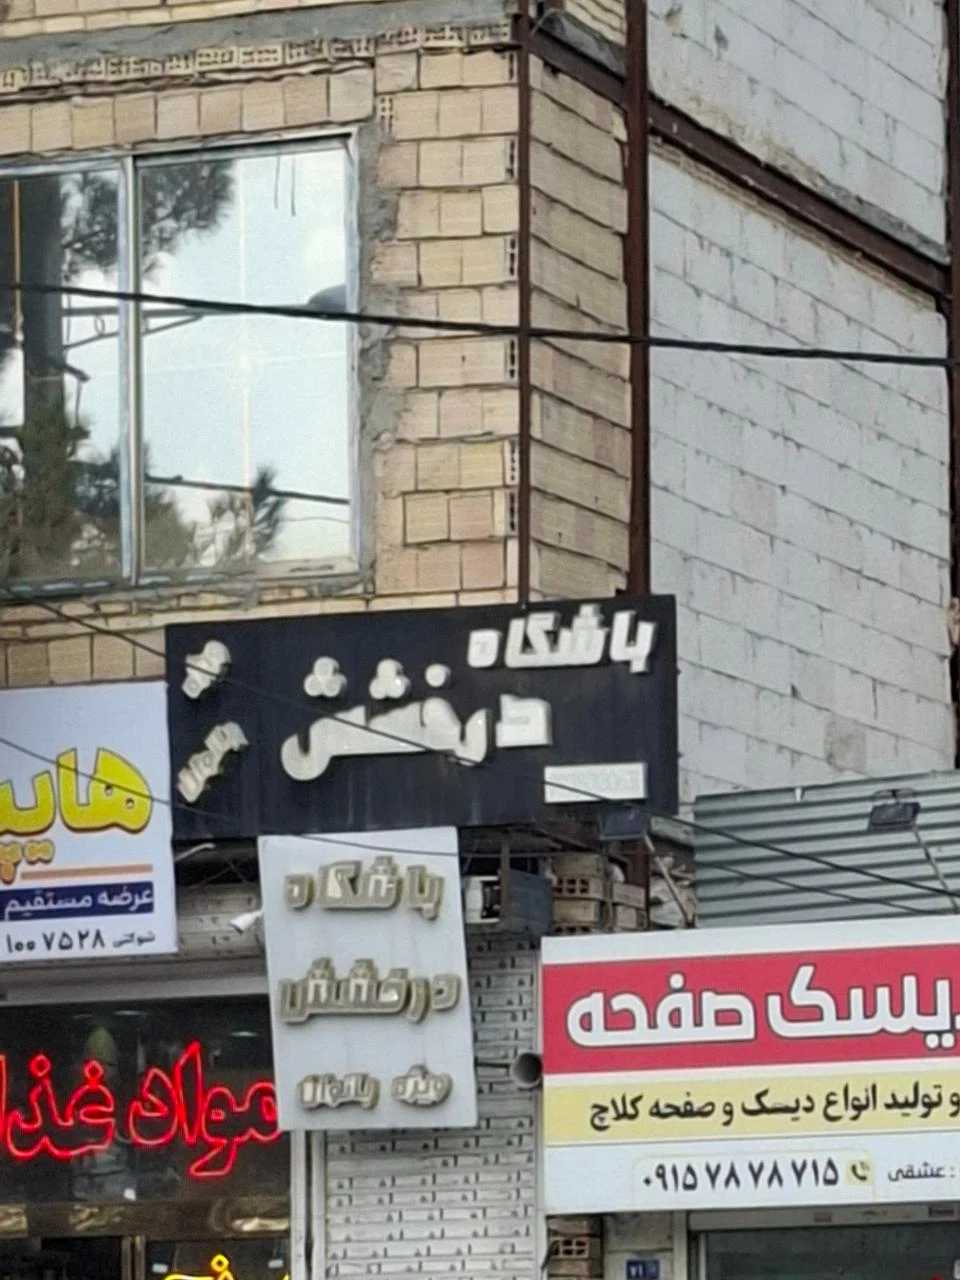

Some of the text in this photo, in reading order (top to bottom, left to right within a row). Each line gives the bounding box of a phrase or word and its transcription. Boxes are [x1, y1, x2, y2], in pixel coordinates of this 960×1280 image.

[467, 603, 656, 674] باشگاه
[281, 656, 552, 782] درخشش
[0, 747, 154, 885] هایپ
[4, 885, 154, 921] عرضه مستقیم
[284, 856, 445, 921] باشگاه
[279, 956, 462, 1025] درخشش
[566, 972, 756, 1049] صفحه
[126, 1039, 282, 1179] مواد
[590, 1093, 643, 1131] کلاچ
[648, 1091, 716, 1119] صفحه
[721, 1100, 734, 1127] و
[741, 1088, 815, 1122] دیسک
[823, 1083, 877, 1122] انواع
[884, 1080, 942, 1118] تولید
[949, 1092, 960, 1117] و
[887, 1161, 945, 1182] عشقی
